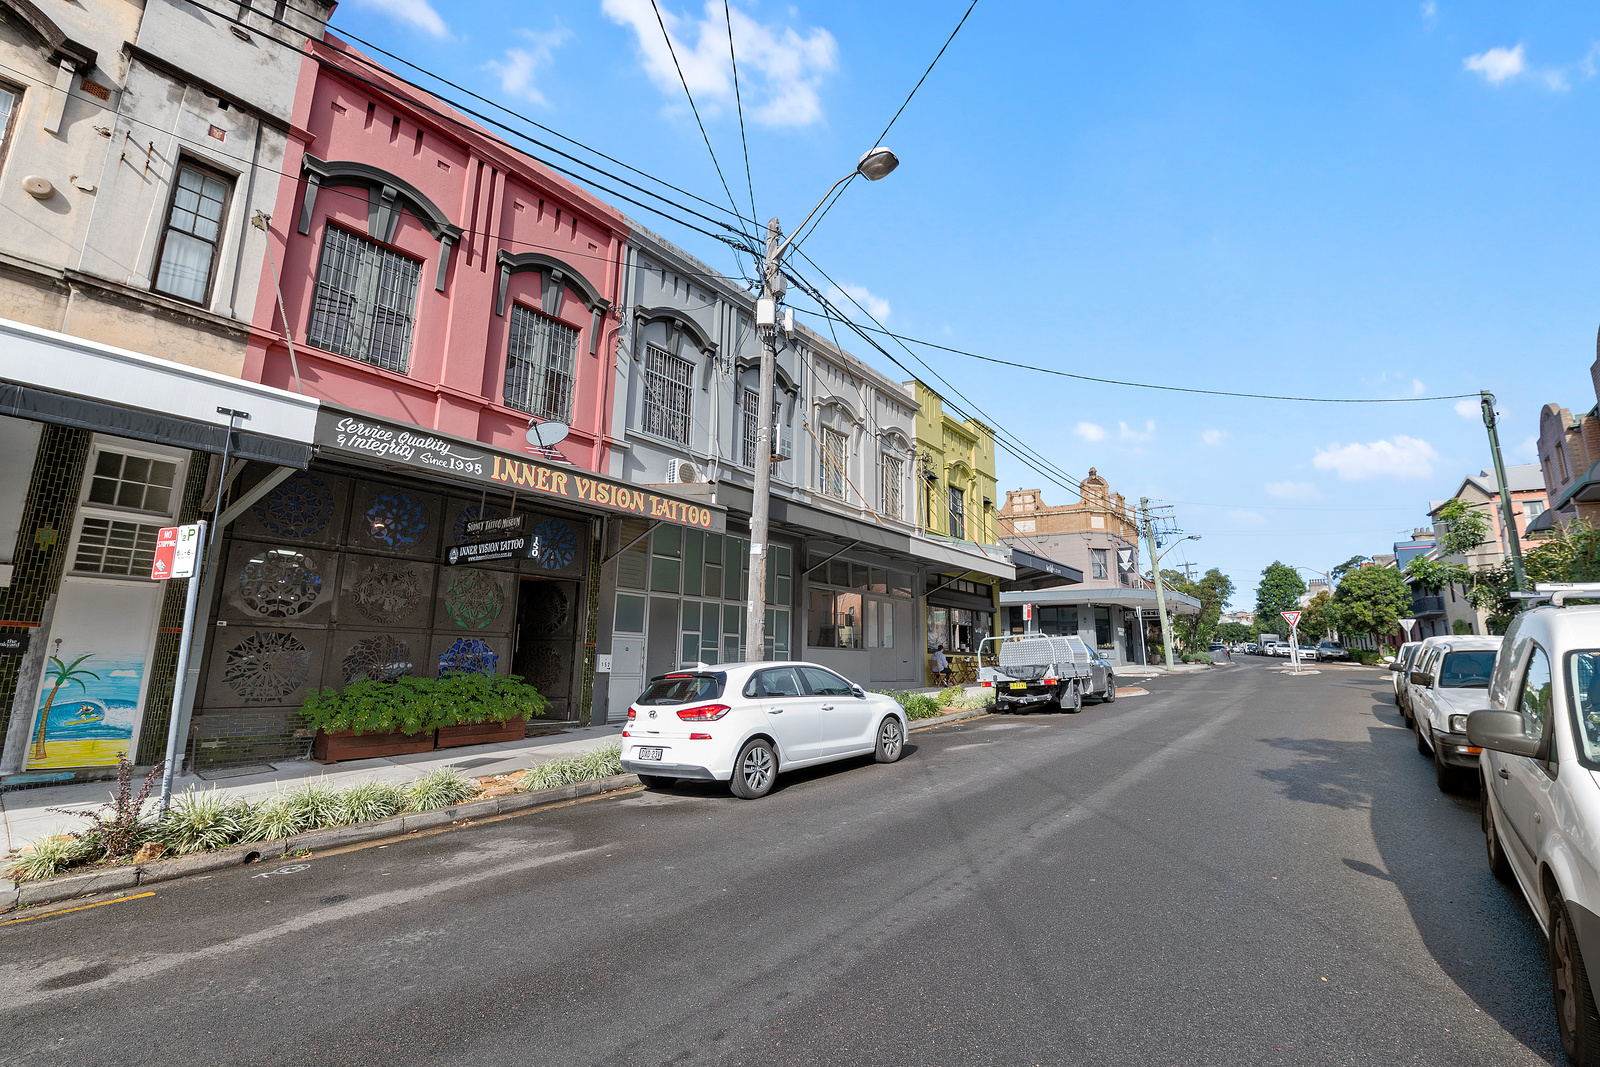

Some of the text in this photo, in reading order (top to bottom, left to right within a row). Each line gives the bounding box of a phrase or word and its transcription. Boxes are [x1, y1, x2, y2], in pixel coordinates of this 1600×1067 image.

[336, 434, 415, 461] & Integrity
[397, 432, 463, 458] Quality
[420, 452, 483, 475] Since 1995
[491, 455, 712, 529] INNER VISION TATTOO
[163, 530, 173, 540] NO
[460, 538, 525, 556] INNER VISION TATTOO
